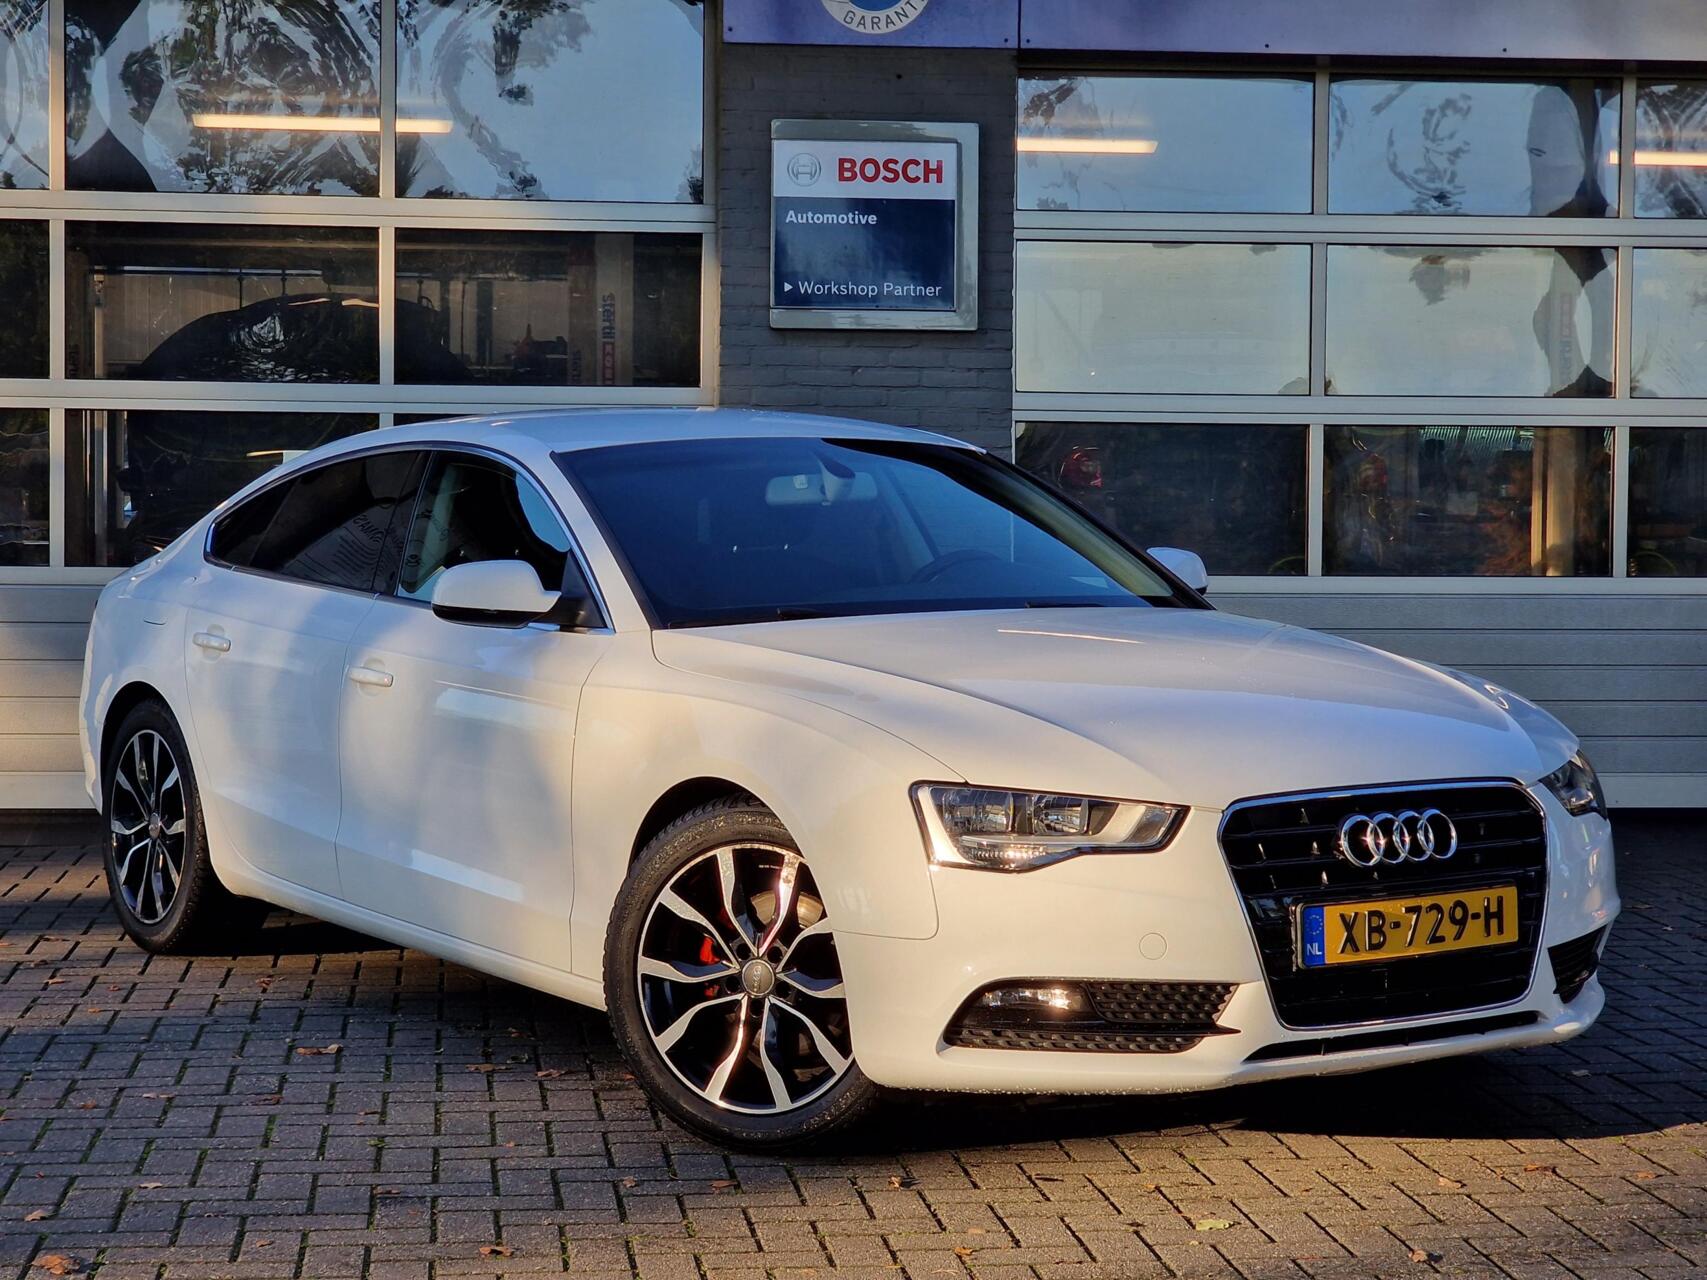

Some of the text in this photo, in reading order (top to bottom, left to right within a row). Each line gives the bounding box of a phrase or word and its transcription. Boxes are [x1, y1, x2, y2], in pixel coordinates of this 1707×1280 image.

[843, 0, 925, 30] GARANT
[837, 157, 944, 184] BOSCH
[785, 210, 878, 225] Automotive
[798, 281, 943, 298] Workshop Partner
[1306, 895, 1505, 956] NL XB-729-H
